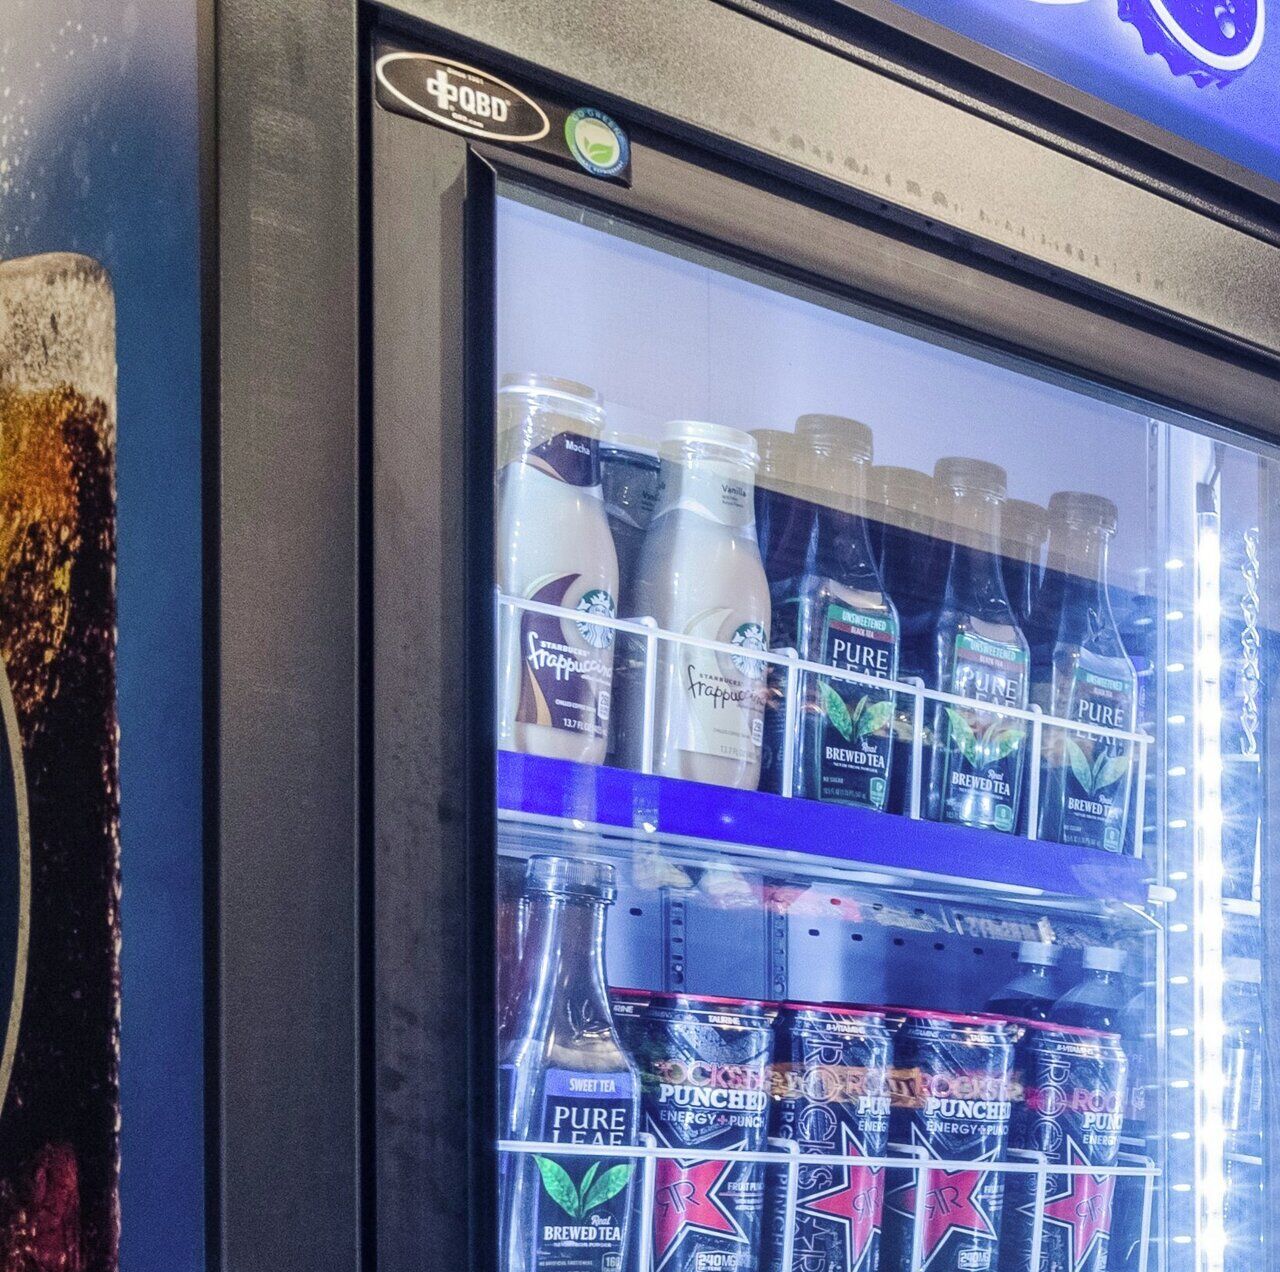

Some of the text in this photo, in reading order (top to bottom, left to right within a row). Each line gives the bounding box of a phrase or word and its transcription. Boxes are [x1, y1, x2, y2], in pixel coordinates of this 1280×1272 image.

[459, 85, 508, 122] QBD
[565, 439, 591, 457] Mocha
[721, 483, 747, 499] Vanilla
[832, 638, 889, 671] PURE
[960, 668, 1019, 700] PURE
[1078, 699, 1125, 728] PURE
[825, 746, 867, 765] BREWED
[867, 753, 885, 769] TEA
[952, 771, 1011, 796] BREWED TEA
[1068, 797, 1102, 816] BREWED
[569, 1078, 615, 1093] SWEET TEA
[659, 1083, 768, 1111] PUNCHED
[553, 1105, 626, 1130] PURE
[660, 1110, 716, 1125] ENERGY
[926, 1120, 978, 1135] ENERGY
[591, 1214, 611, 1226] Real
[543, 1226, 621, 1241] BREWED TEA
